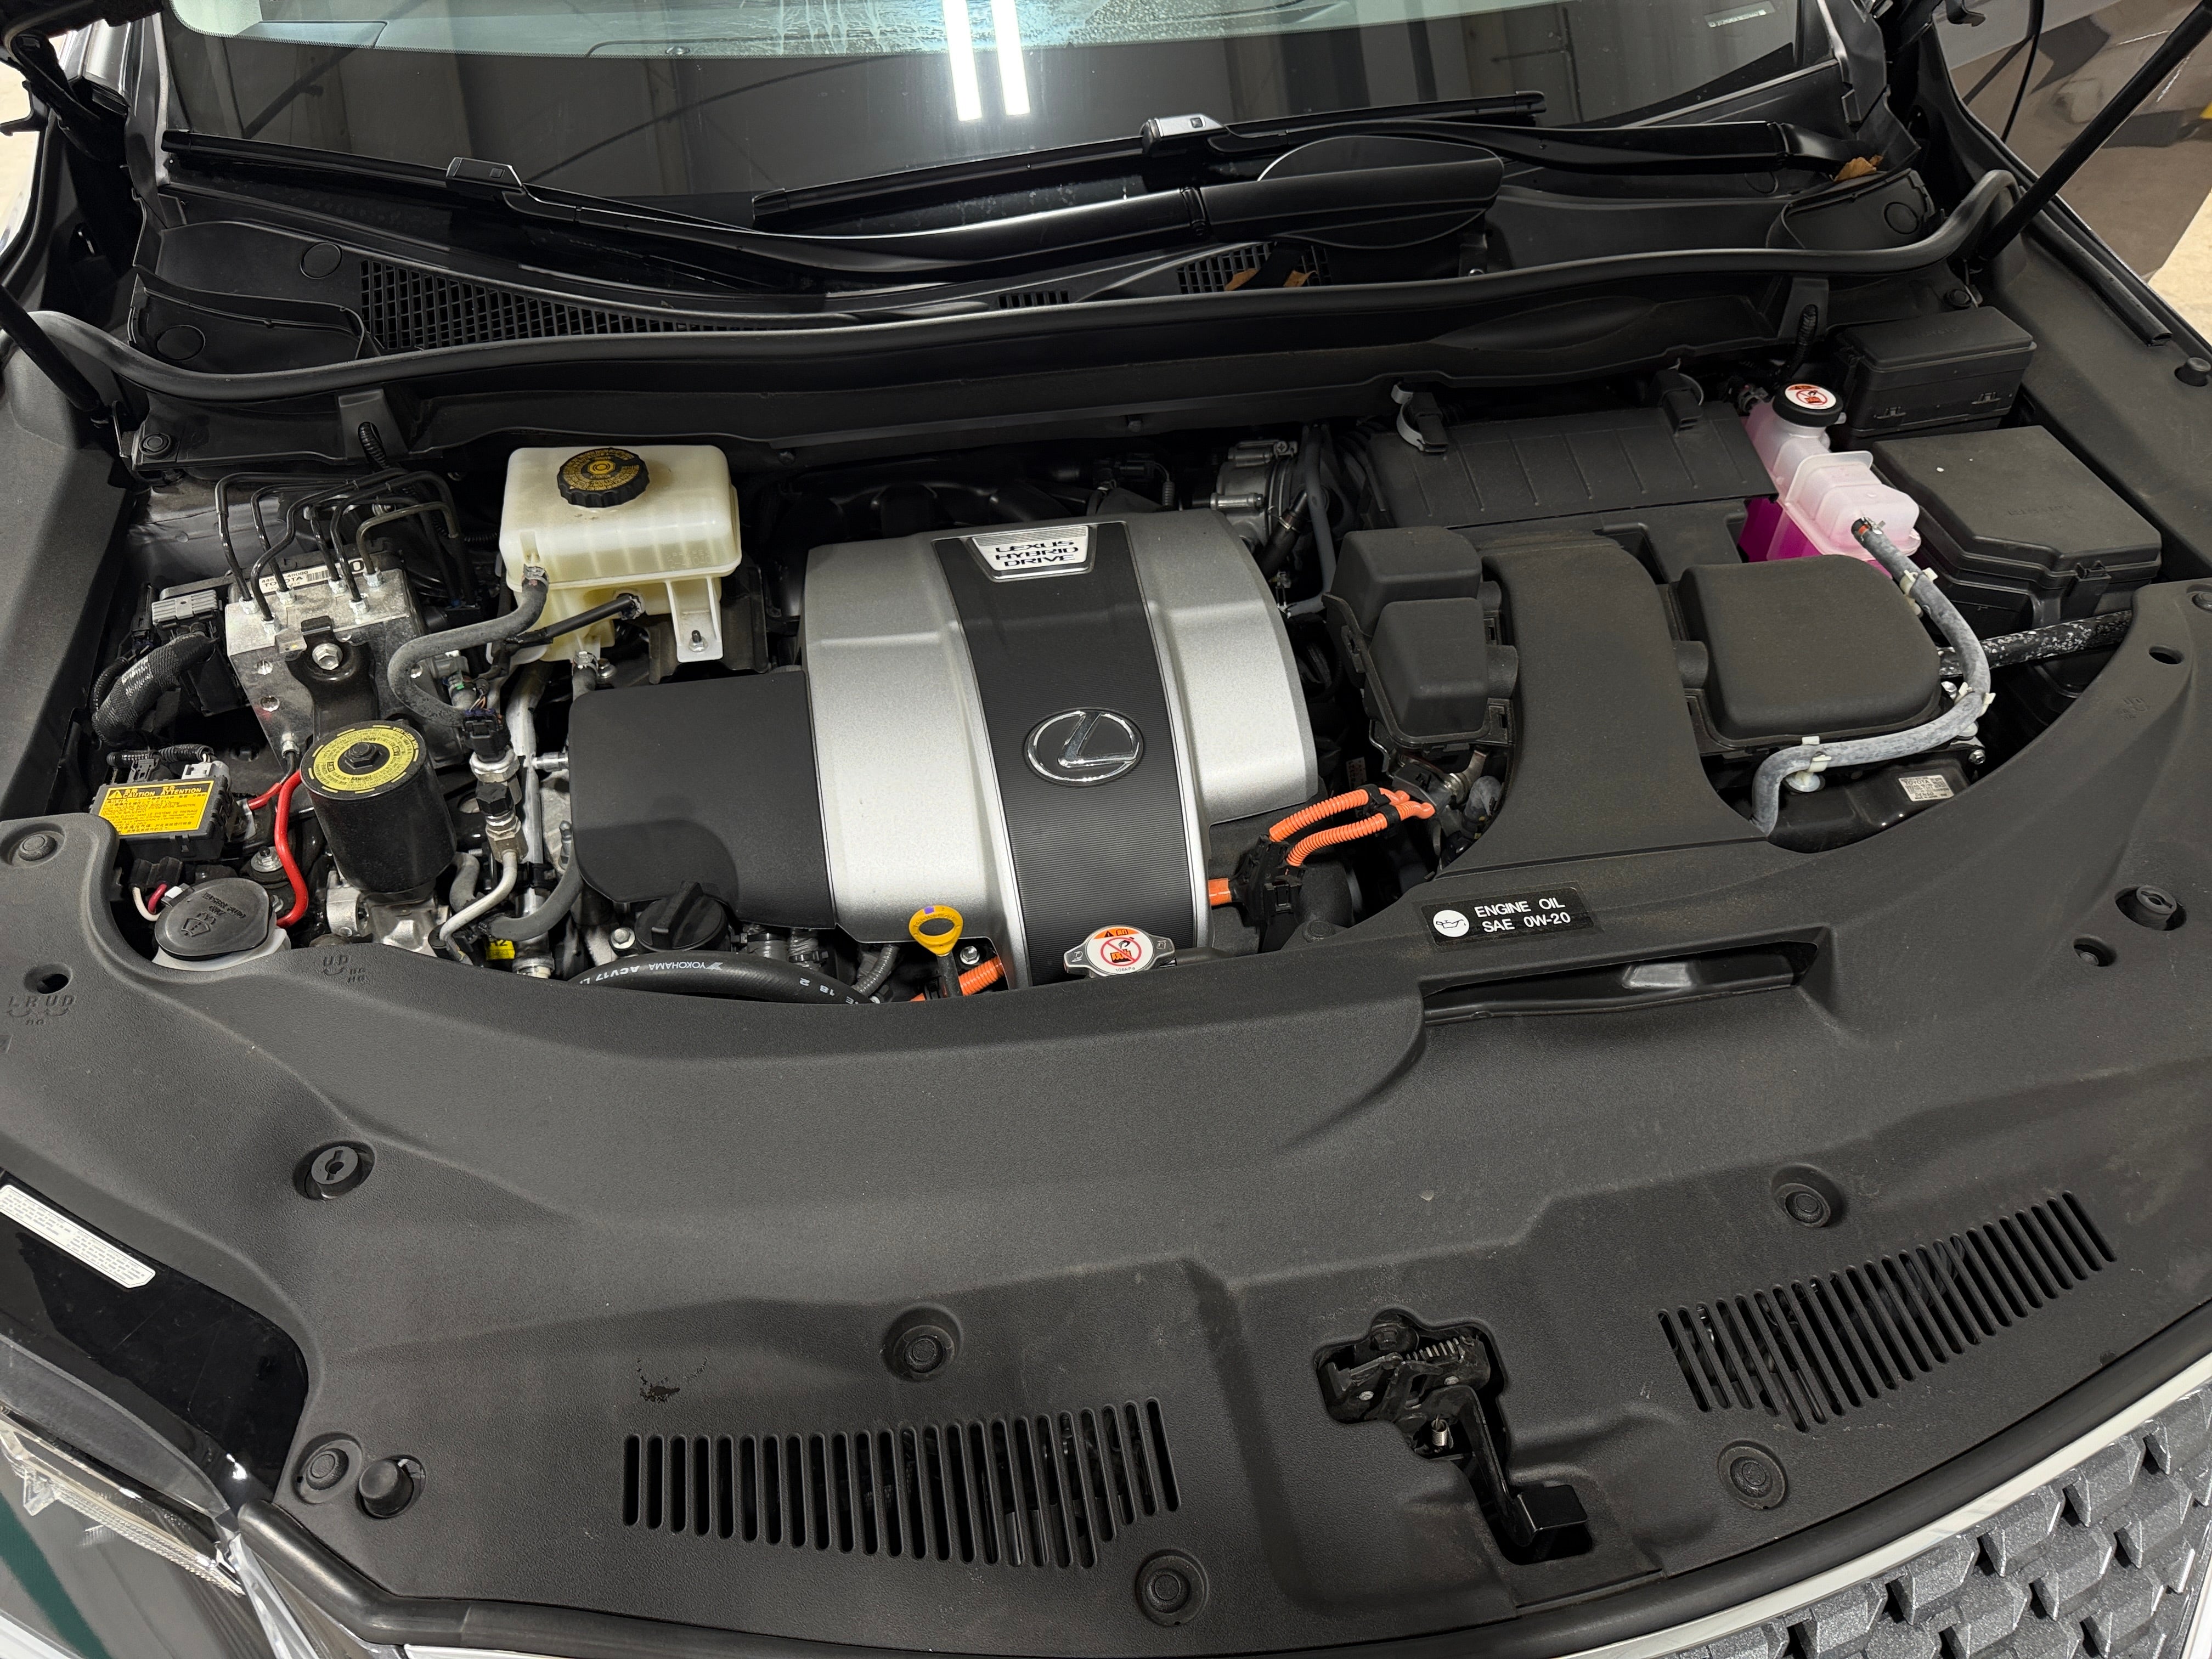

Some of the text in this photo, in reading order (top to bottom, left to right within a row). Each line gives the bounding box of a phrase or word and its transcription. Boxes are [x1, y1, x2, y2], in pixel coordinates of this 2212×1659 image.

[995, 540, 1074, 552] LEXUS
[995, 547, 1079, 560] HYBRID
[1004, 555, 1075, 567] DRIVE
[1474, 898, 1566, 918] ENGINE OIL
[1482, 912, 1571, 933] SAE 0W-20
[648, 962, 706, 970] YOKOHAMA
[595, 965, 640, 981] ACV17
